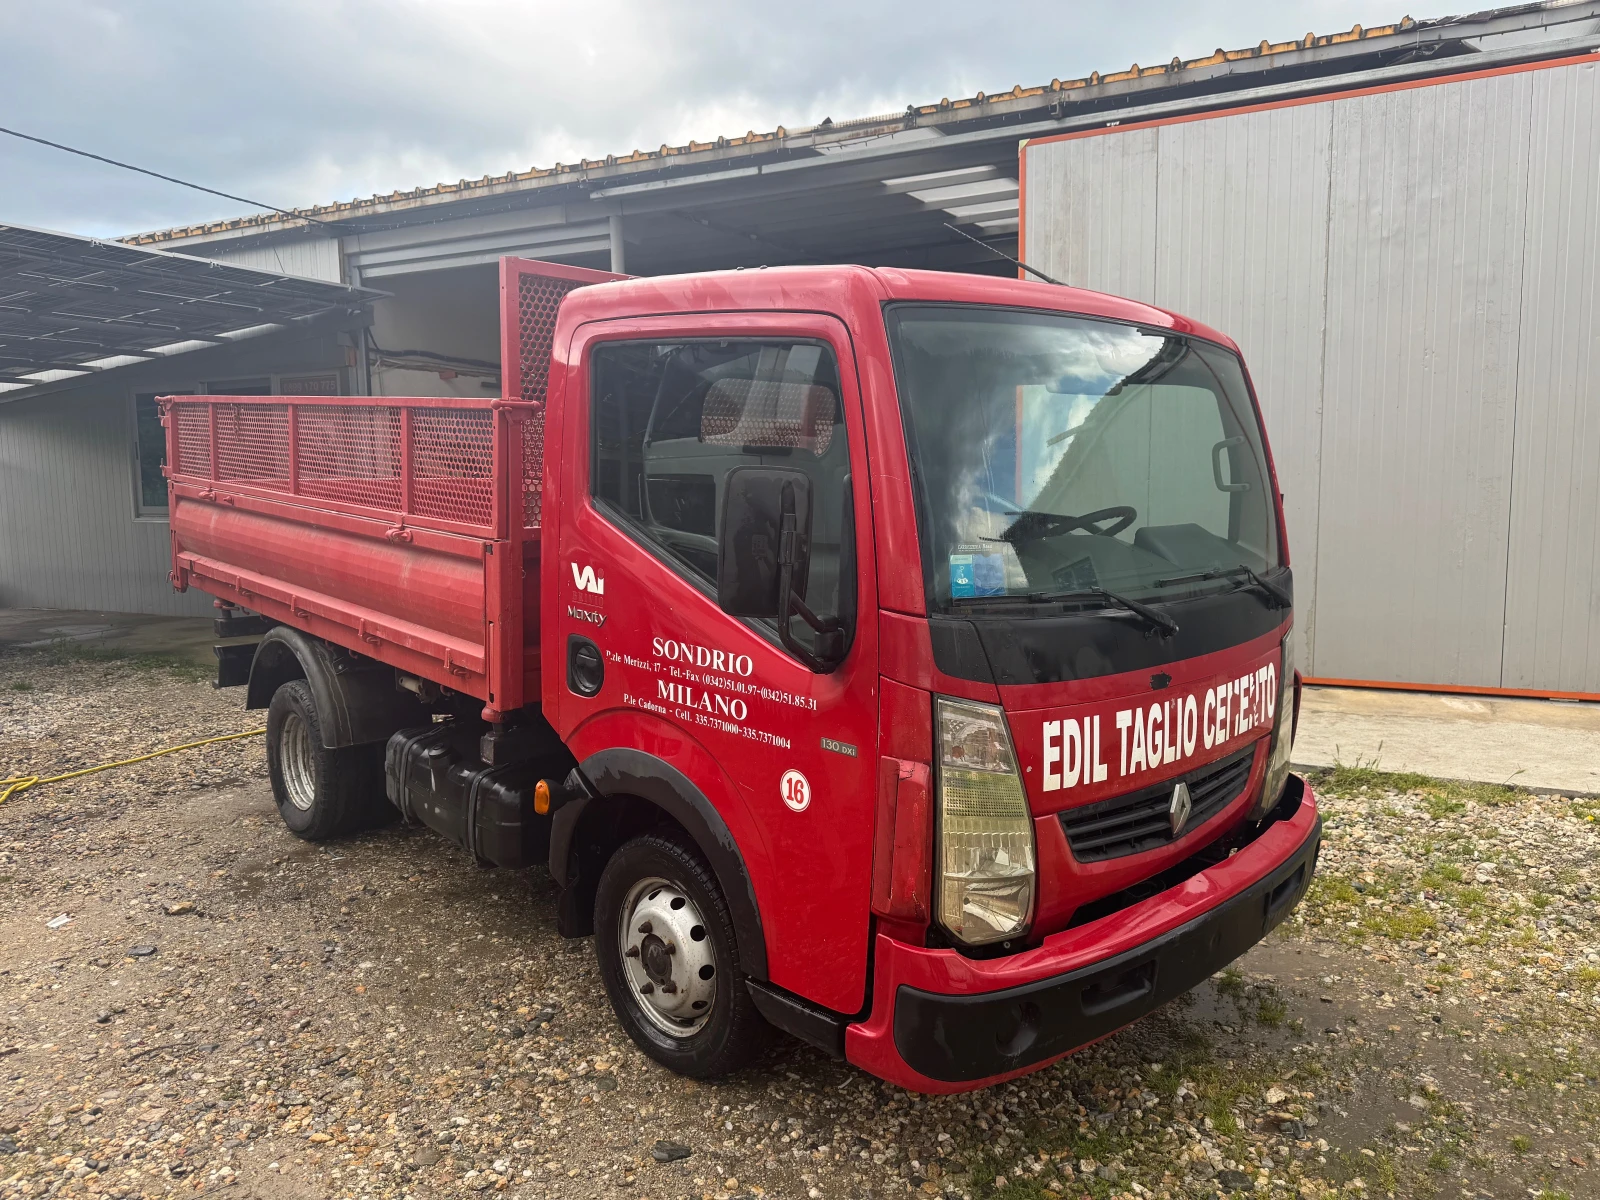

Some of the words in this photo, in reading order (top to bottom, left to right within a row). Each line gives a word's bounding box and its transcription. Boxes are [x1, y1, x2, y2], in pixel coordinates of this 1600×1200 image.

[568, 604, 607, 627] Maxity
[623, 654, 652, 672] Merizzi,
[653, 662, 661, 673] 17
[652, 636, 753, 677] SONDRIO
[623, 693, 637, 706] P.le
[638, 697, 667, 714] Cadorna
[675, 708, 693, 722] Cell.
[656, 678, 748, 721] MILANO
[822, 739, 839, 751] 130
[1042, 714, 1108, 793] EDIL
[1115, 693, 1198, 777] TAGLIO
[786, 777, 805, 805] 16
